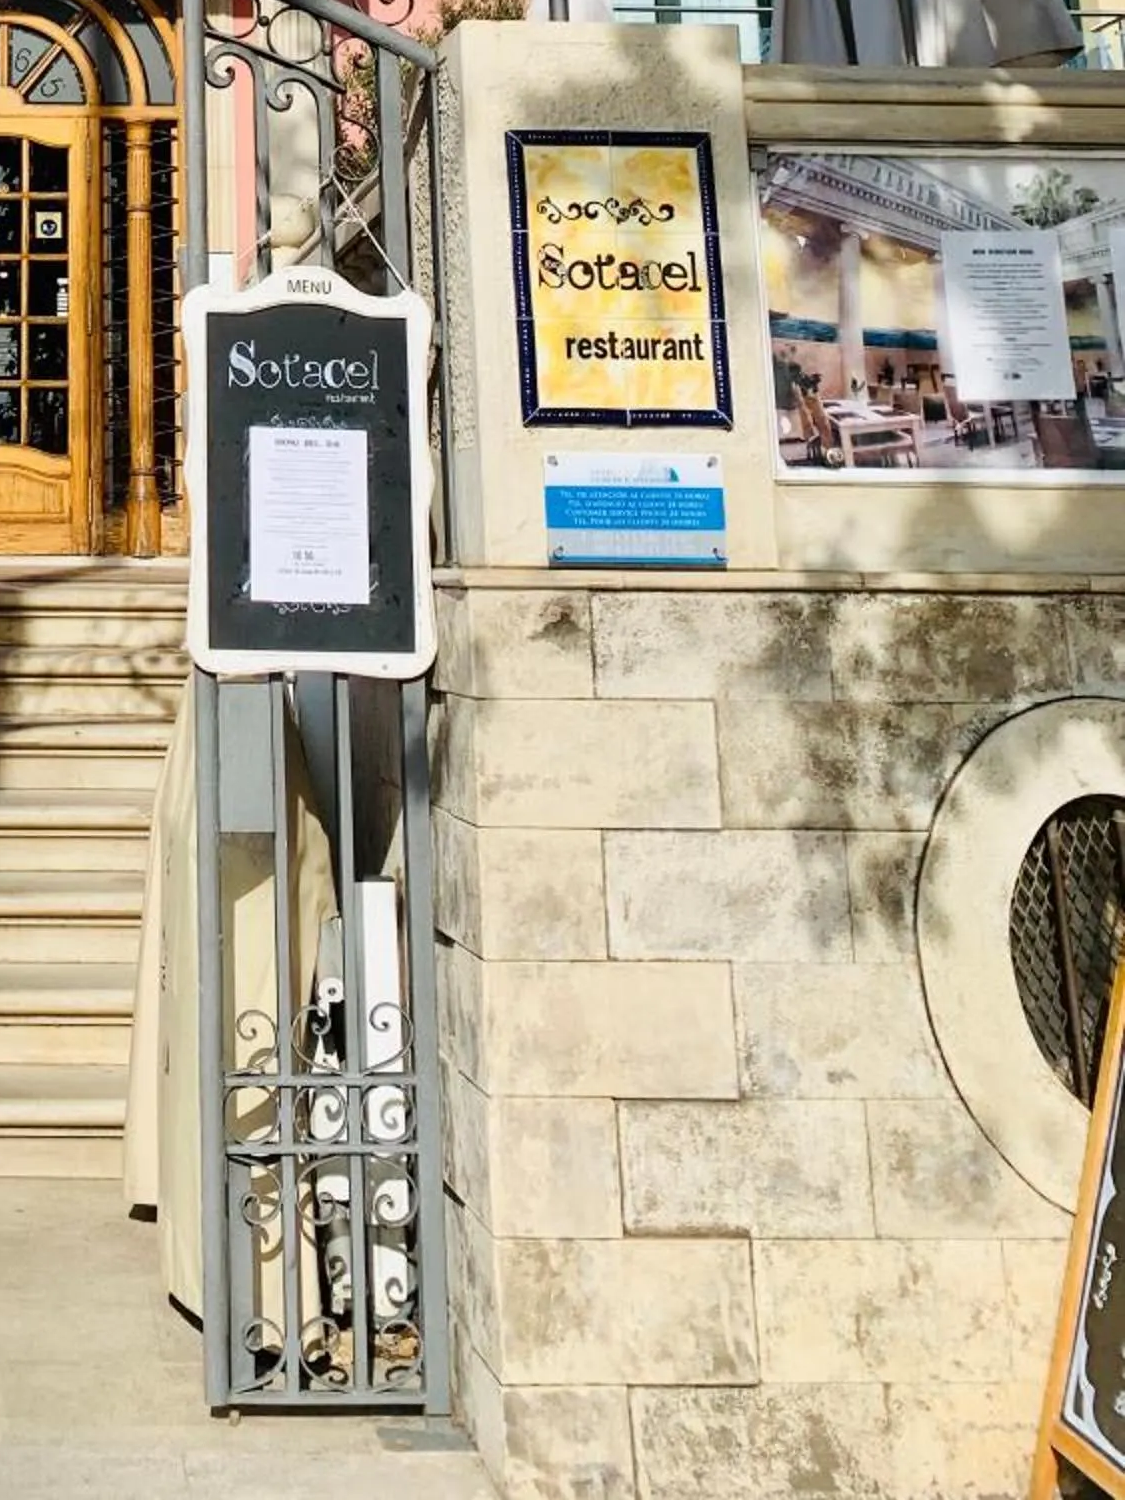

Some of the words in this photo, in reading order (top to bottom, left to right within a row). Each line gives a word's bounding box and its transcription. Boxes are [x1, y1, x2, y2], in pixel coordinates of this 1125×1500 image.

[286, 278, 332, 295] MENU
[538, 243, 702, 292] Sotacel
[227, 339, 380, 391] Sotacel
[565, 331, 705, 362] restaurant
